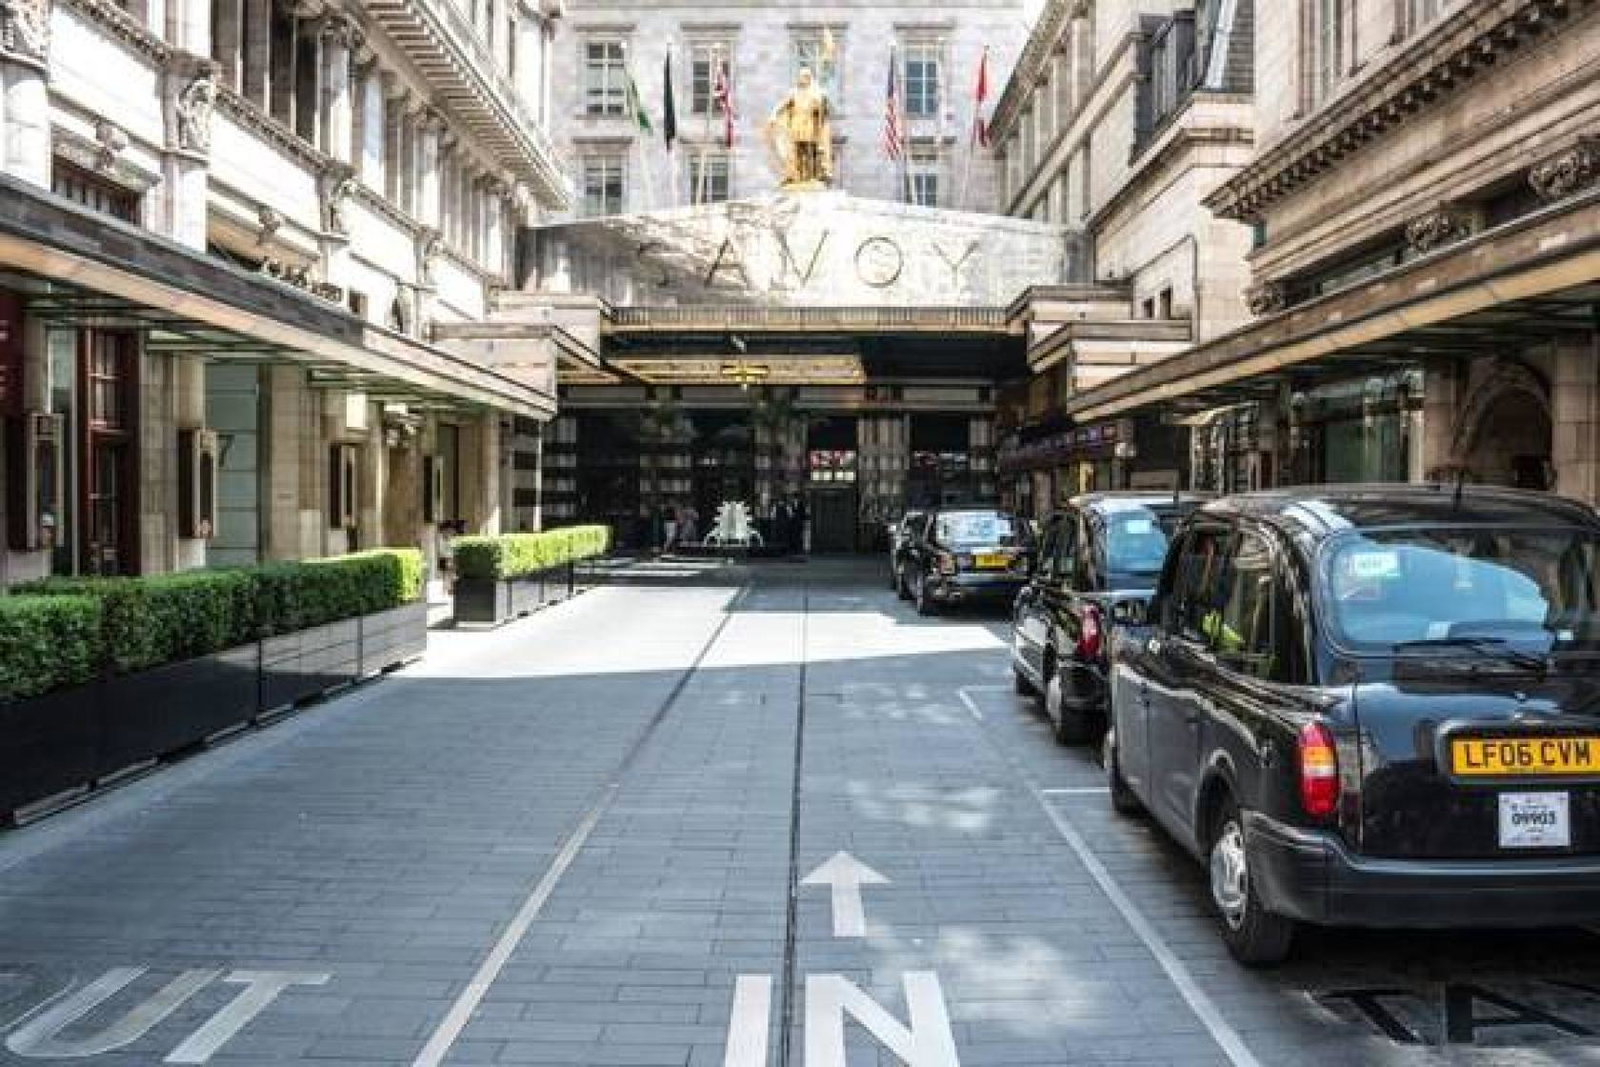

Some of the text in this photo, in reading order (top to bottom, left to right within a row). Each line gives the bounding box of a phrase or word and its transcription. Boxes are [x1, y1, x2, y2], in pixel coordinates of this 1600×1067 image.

[1464, 740, 1592, 768] LF06 CVM
[0, 962, 330, 1064] UT
[724, 970, 960, 1067] IN
